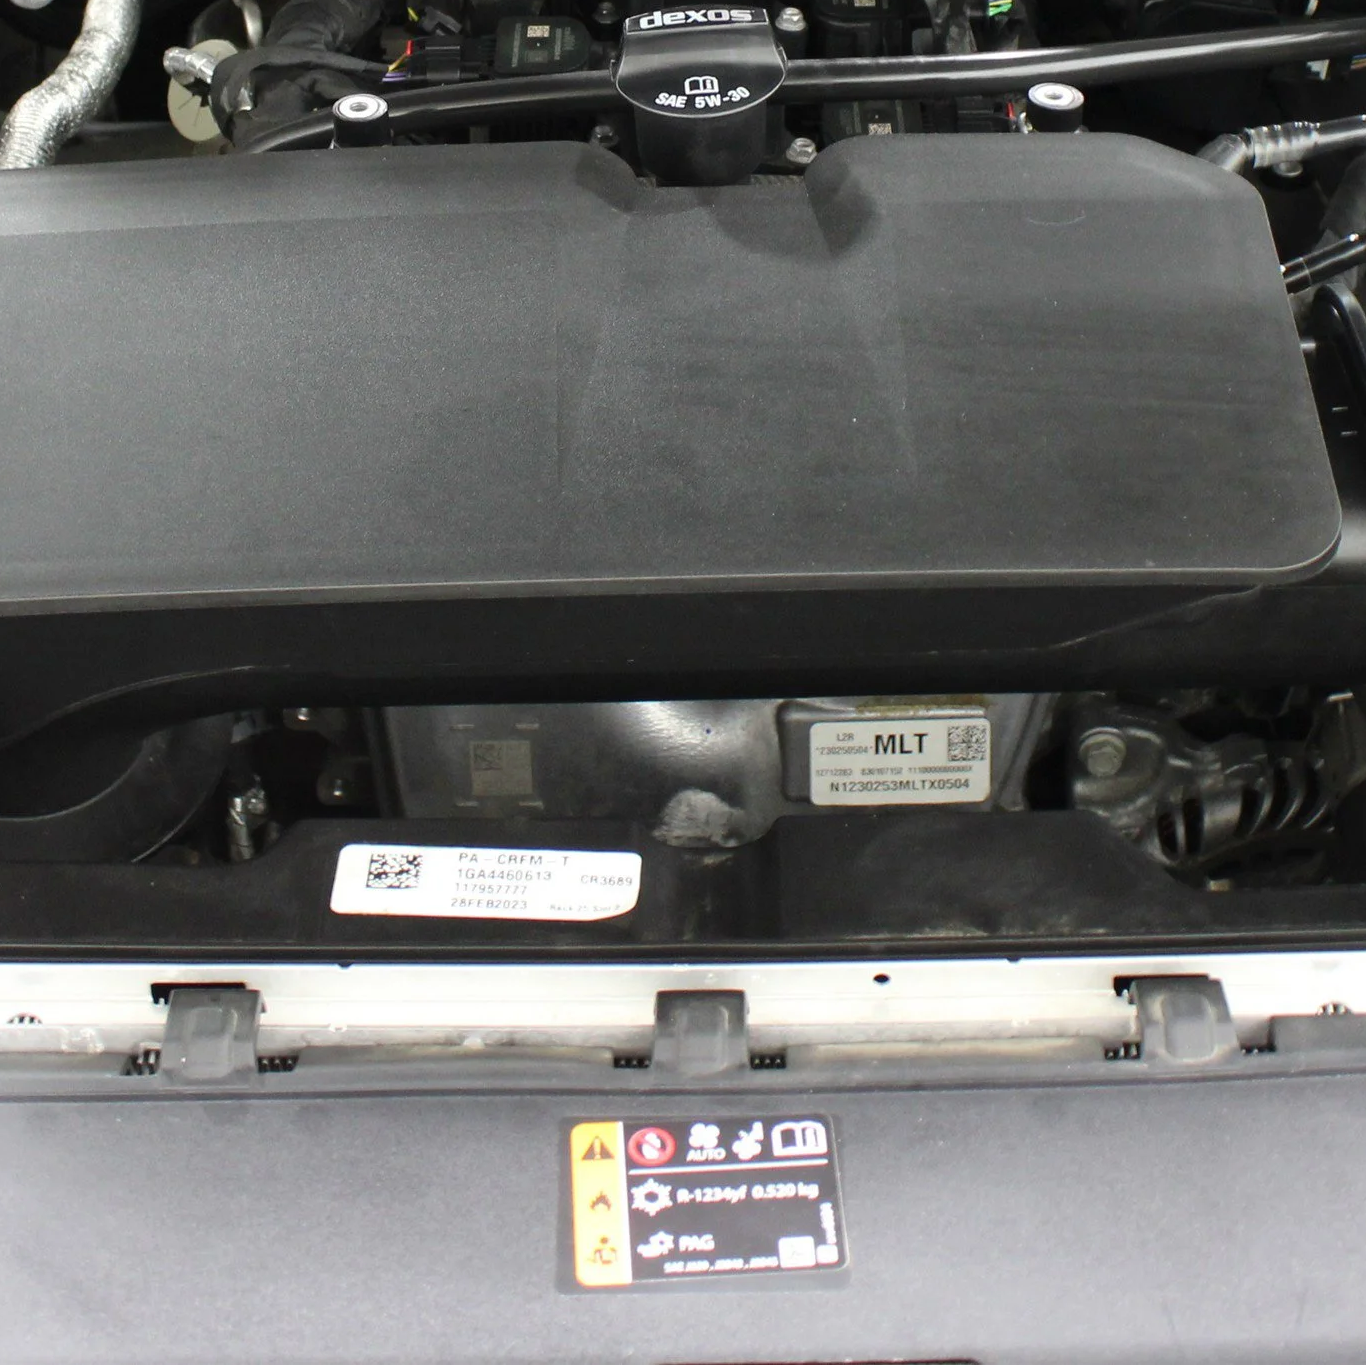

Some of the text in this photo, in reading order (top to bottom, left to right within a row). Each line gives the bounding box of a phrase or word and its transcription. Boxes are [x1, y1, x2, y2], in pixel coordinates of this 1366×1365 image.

[639, 9, 753, 29] dexos
[655, 86, 751, 109] SAE 5W-30
[874, 733, 928, 755] MLT
[830, 778, 970, 793] N1230253MLTX0504
[457, 868, 553, 881] 1GA4460613
[580, 875, 634, 887] CR3689
[455, 882, 528, 895] 117957777
[450, 898, 528, 910] 28FEB2023
[686, 1148, 726, 1162] AUTO
[677, 1181, 819, 1204] R-1234yf 0.520 kg
[678, 1234, 716, 1252] PAG
